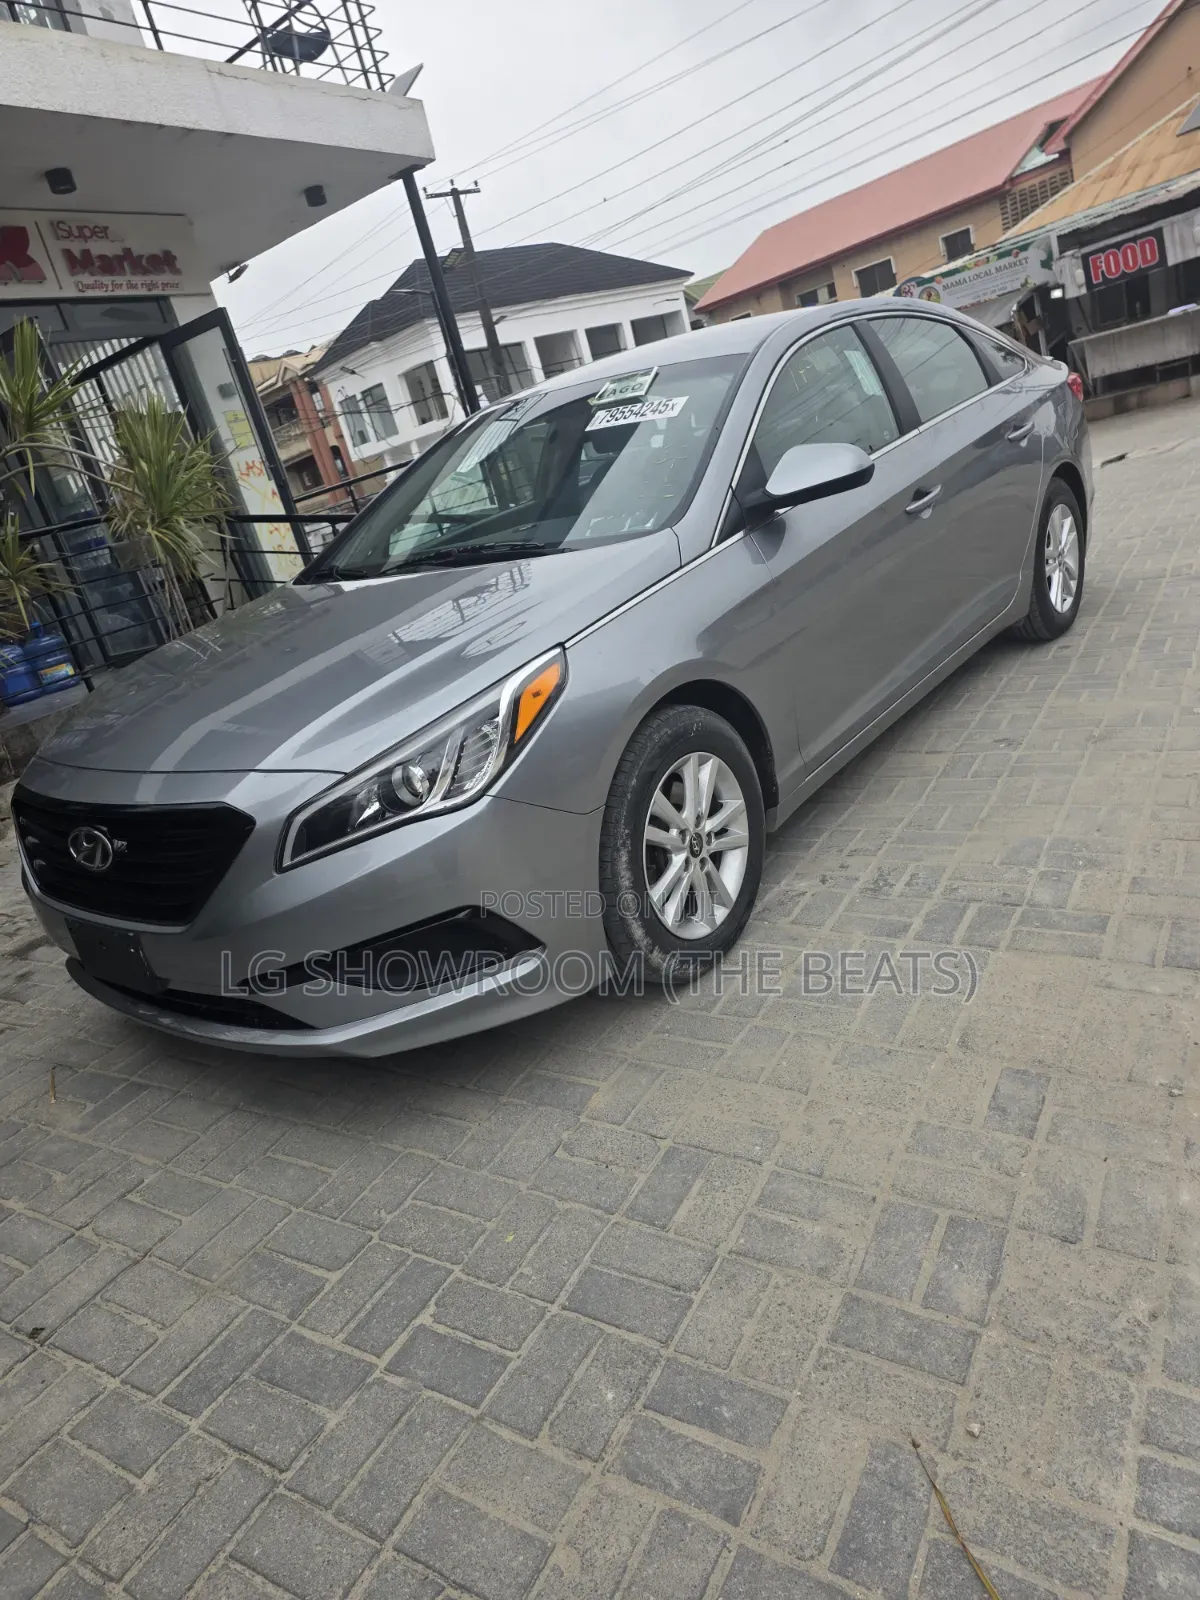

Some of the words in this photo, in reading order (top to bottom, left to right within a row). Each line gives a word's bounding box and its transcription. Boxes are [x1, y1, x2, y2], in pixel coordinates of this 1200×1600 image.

[56, 220, 110, 242] Super
[62, 247, 183, 276] Market
[942, 278, 968, 291] MAMA
[969, 269, 994, 282] LOCAL
[995, 256, 1029, 274] MARKET
[1089, 236, 1159, 284] FOOD
[76, 280, 109, 292] Quality
[111, 280, 124, 292] for
[126, 280, 139, 290] the
[141, 281, 159, 292] right
[161, 282, 180, 291] price
